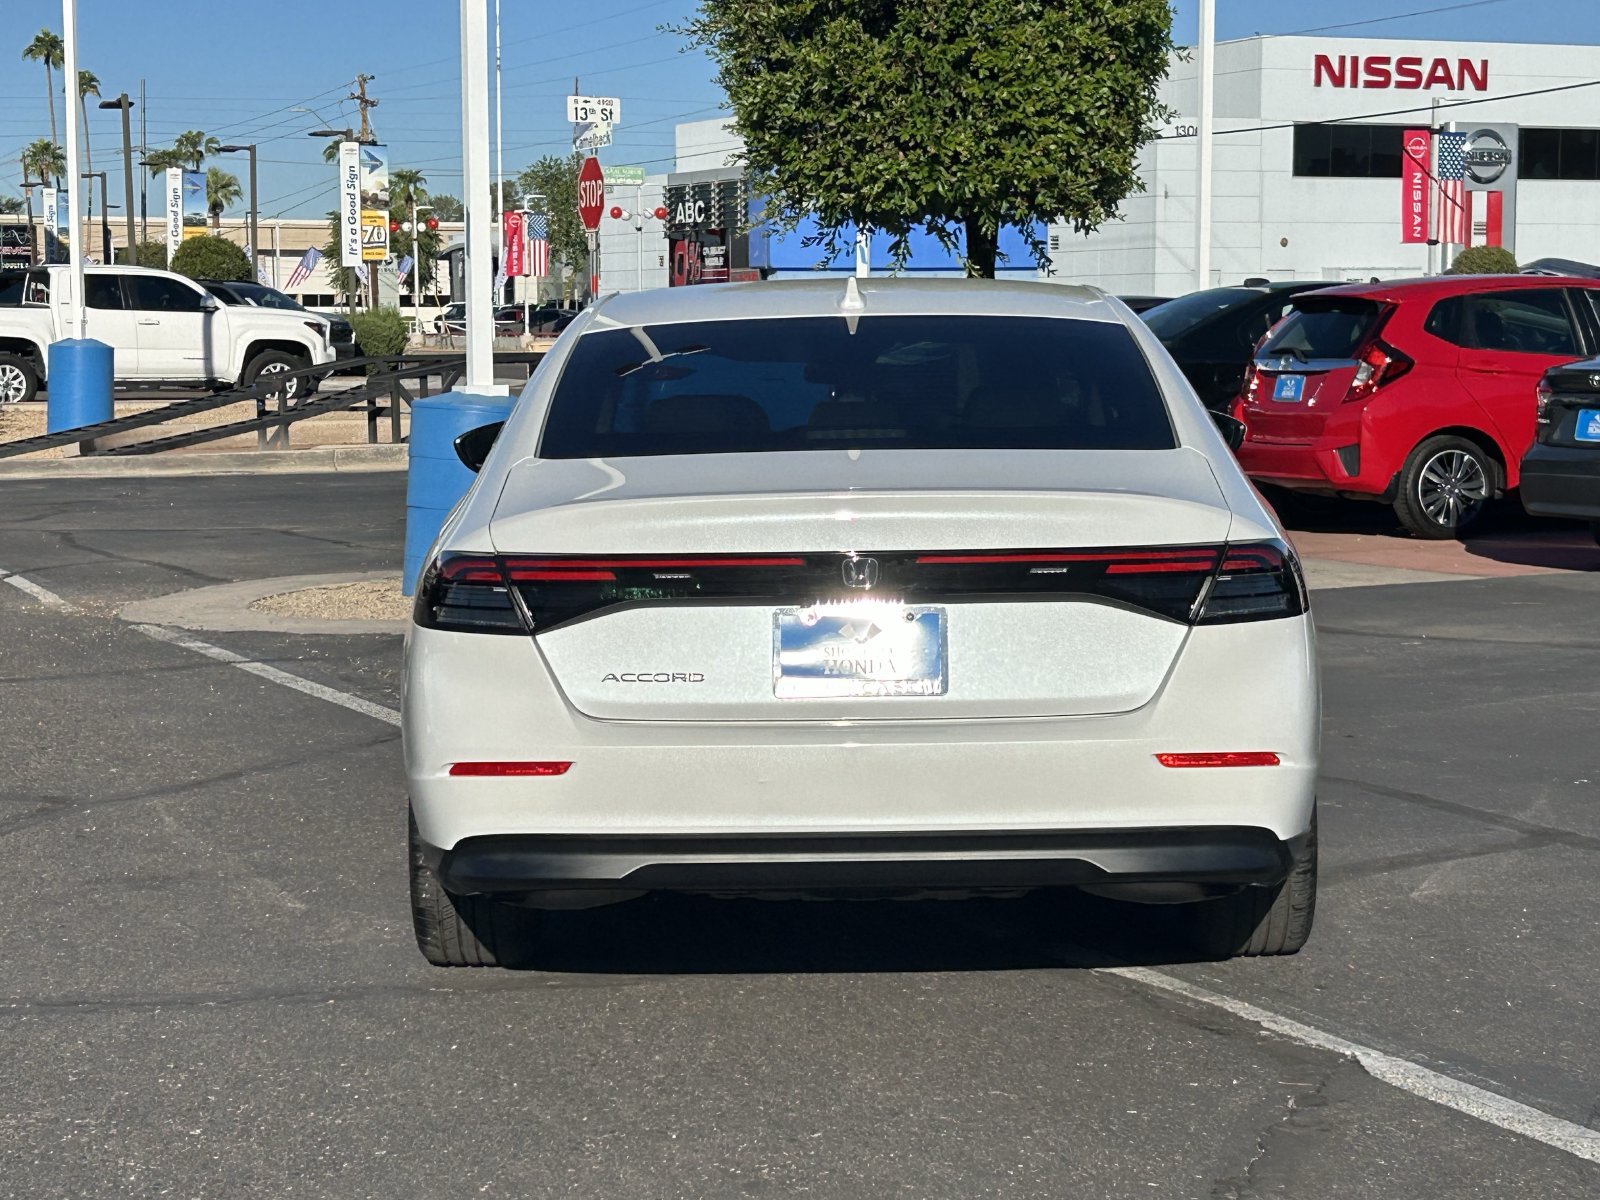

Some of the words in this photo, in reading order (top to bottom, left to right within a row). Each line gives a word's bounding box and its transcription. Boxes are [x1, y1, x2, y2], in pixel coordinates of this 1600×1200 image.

[1314, 54, 1488, 91] NISSAN
[601, 108, 613, 121] St
[346, 165, 358, 191] Sign
[170, 187, 181, 209] Sign
[580, 180, 603, 208] STOP
[1413, 172, 1422, 238] NISSAN
[346, 193, 357, 225] Good
[676, 200, 705, 223] ABC
[170, 210, 179, 238] Good
[350, 228, 357, 236] a
[601, 672, 705, 683] ACCORD
